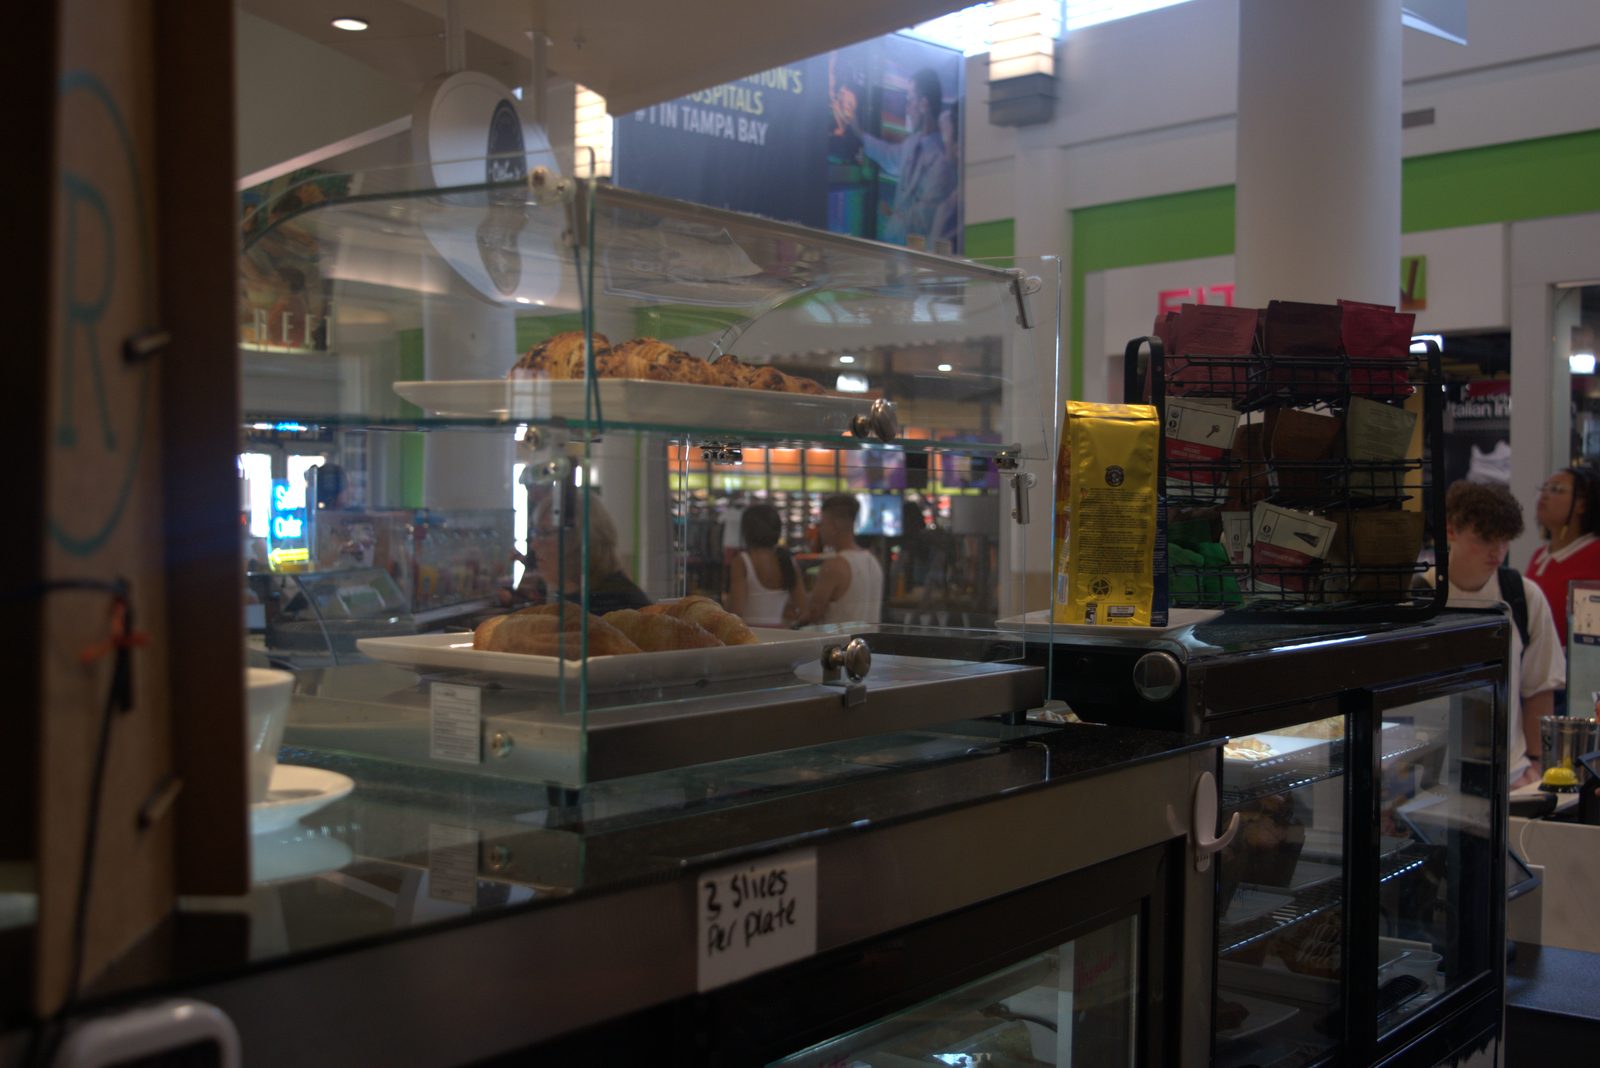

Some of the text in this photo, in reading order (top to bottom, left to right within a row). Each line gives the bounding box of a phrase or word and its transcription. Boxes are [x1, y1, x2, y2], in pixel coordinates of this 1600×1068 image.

[685, 83, 764, 115] SPITALS
[659, 102, 678, 129] IN
[682, 106, 735, 140] TAMPA
[737, 117, 769, 147] BAY
